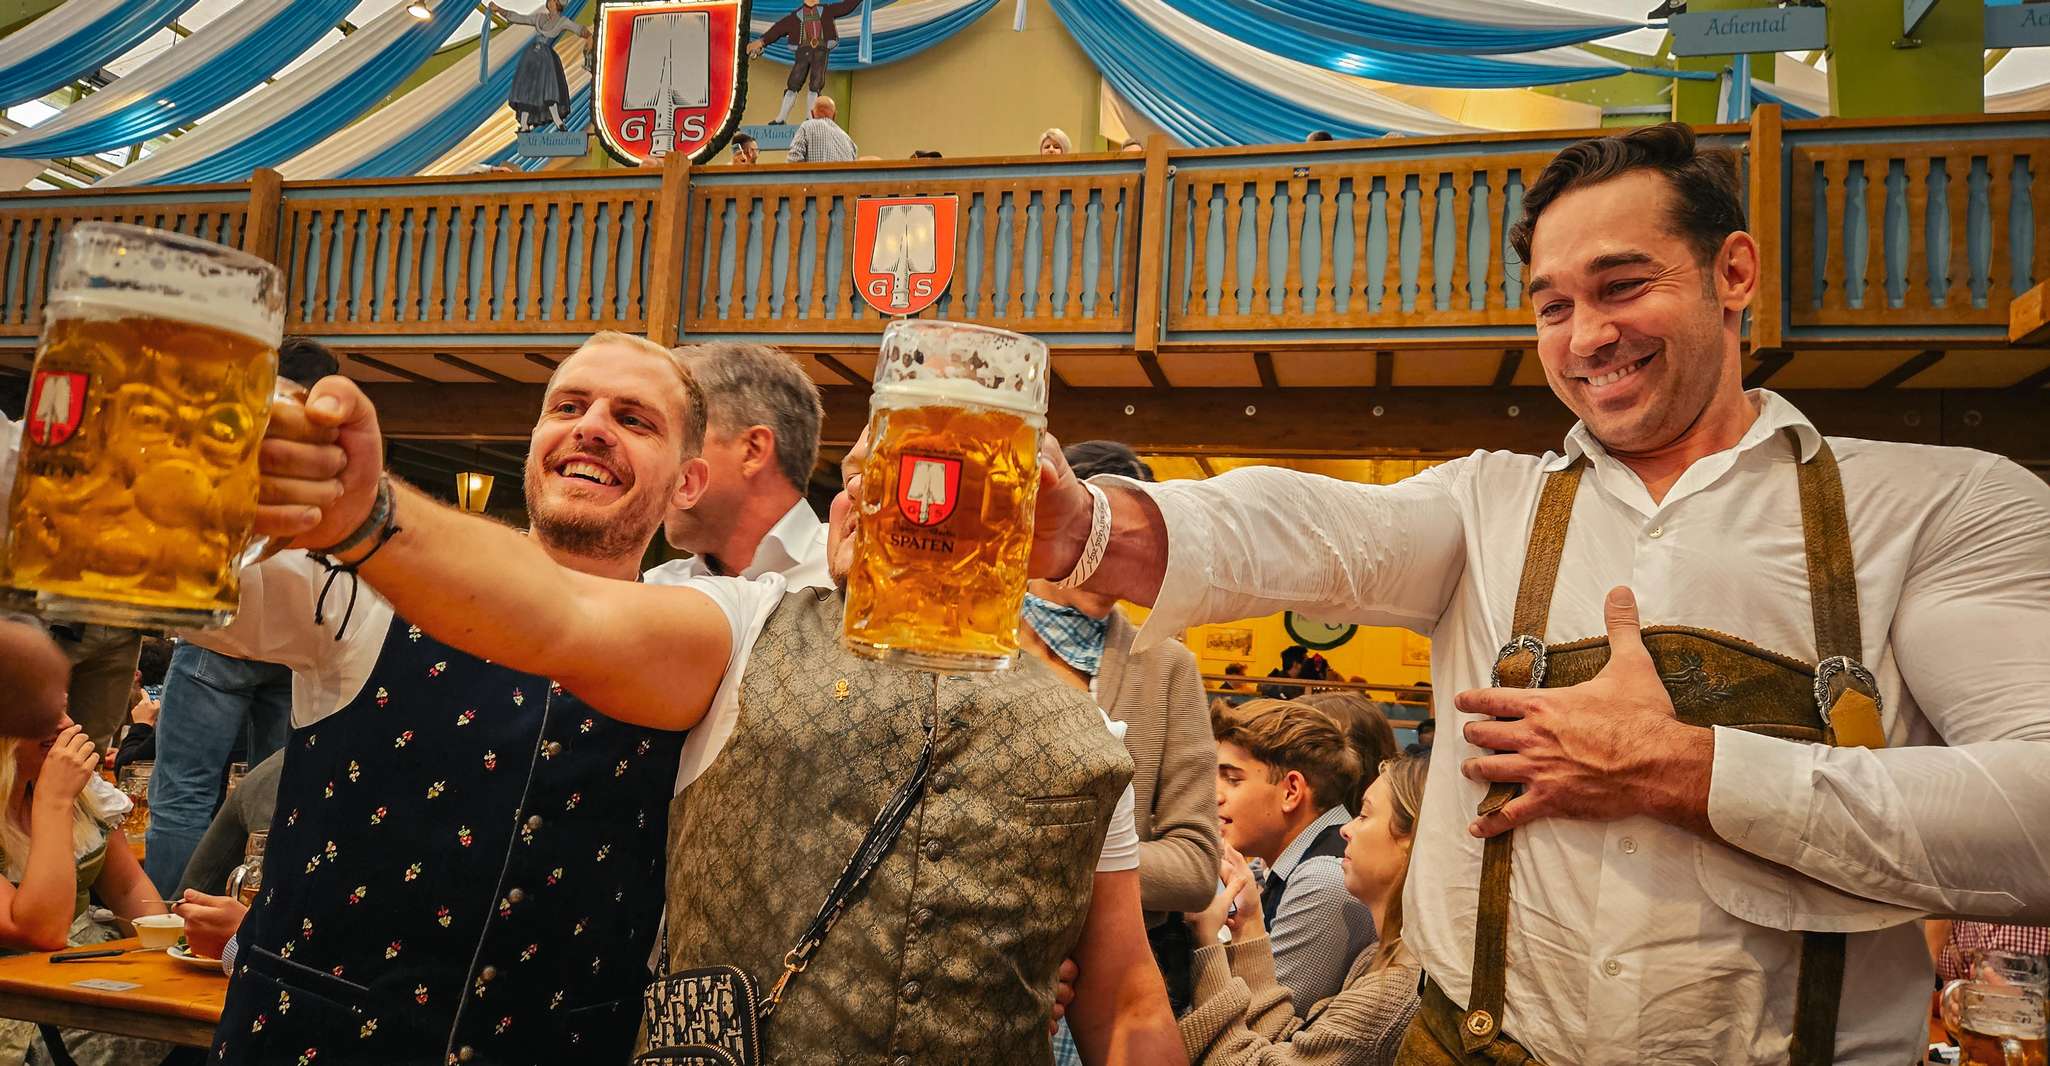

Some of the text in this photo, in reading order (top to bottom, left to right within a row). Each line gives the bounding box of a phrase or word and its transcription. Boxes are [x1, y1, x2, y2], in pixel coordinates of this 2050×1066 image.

[1703, 12, 1791, 36] Achental
[620, 114, 706, 142] G S
[868, 278, 932, 297] G S
[890, 532, 955, 553] SPATEN
